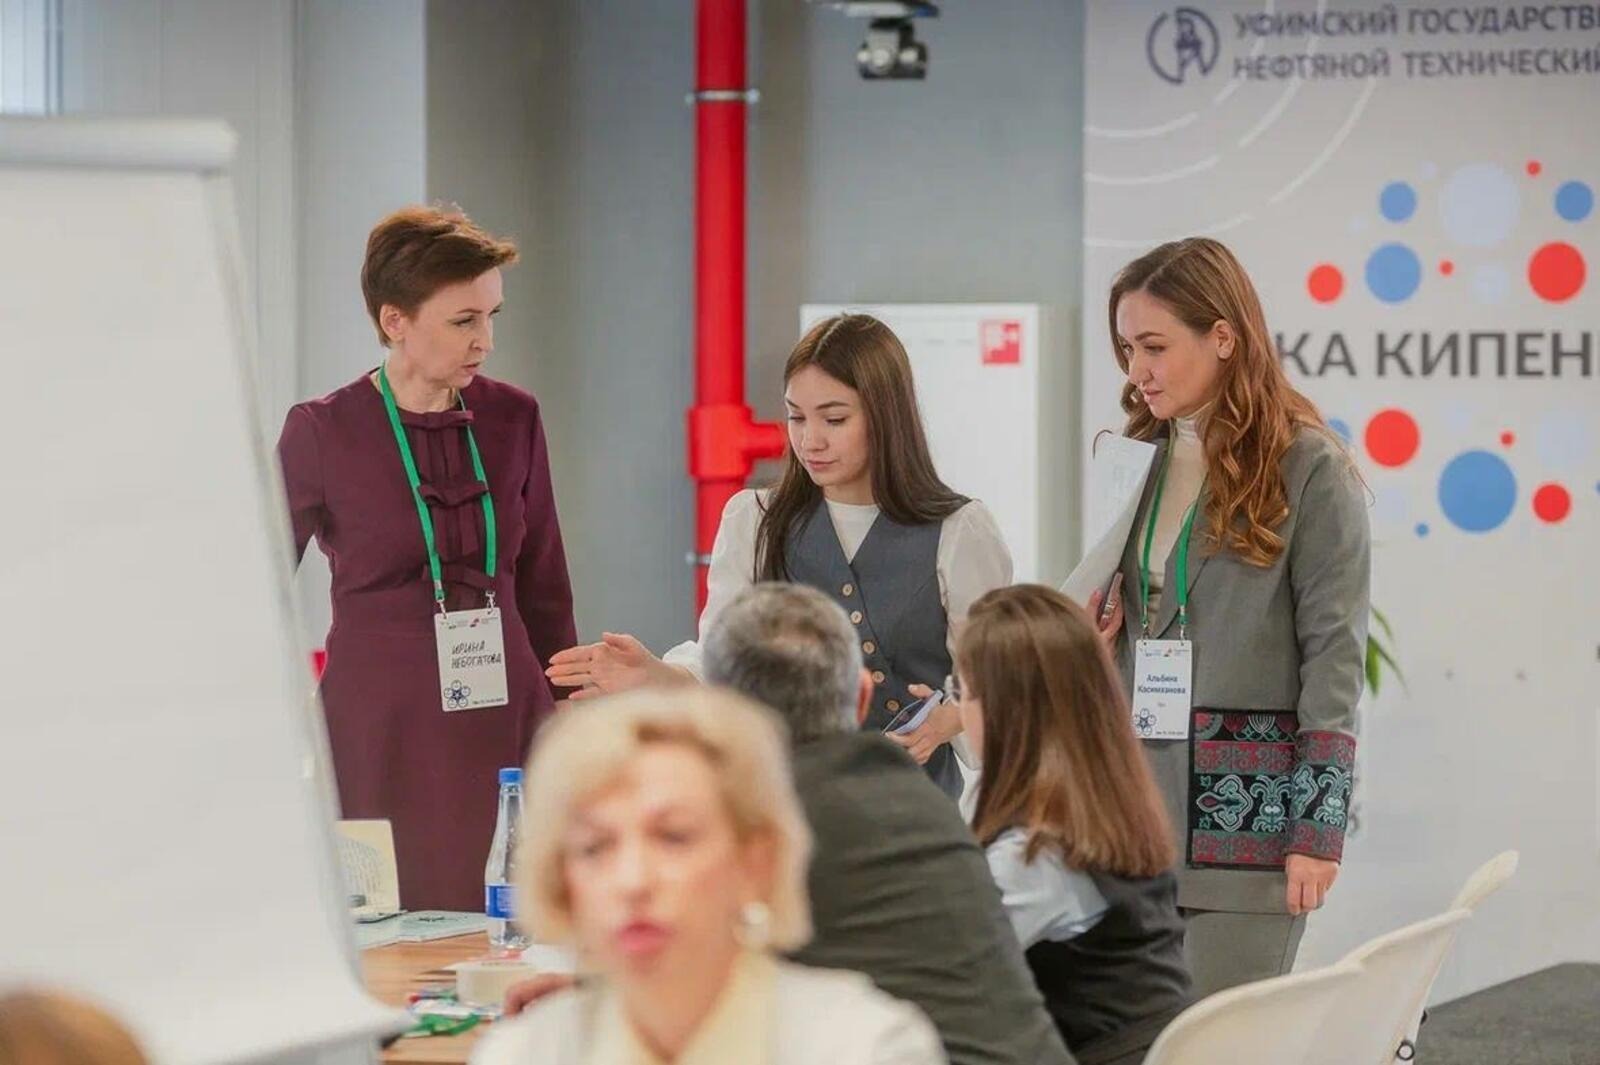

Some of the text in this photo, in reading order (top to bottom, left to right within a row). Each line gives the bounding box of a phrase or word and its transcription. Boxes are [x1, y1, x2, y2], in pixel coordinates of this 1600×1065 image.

[1233, 3, 1600, 38] УФИМСКИЙ ГОСУДАРСТВ
[1234, 49, 1390, 79] НЕФТЯНОЙ
[1376, 332, 1592, 377] КИПЕН
[452, 640, 485, 655] ИРИНА
[451, 653, 501, 669] НЕБОГАТОВА
[1146, 674, 1178, 683] Альбина
